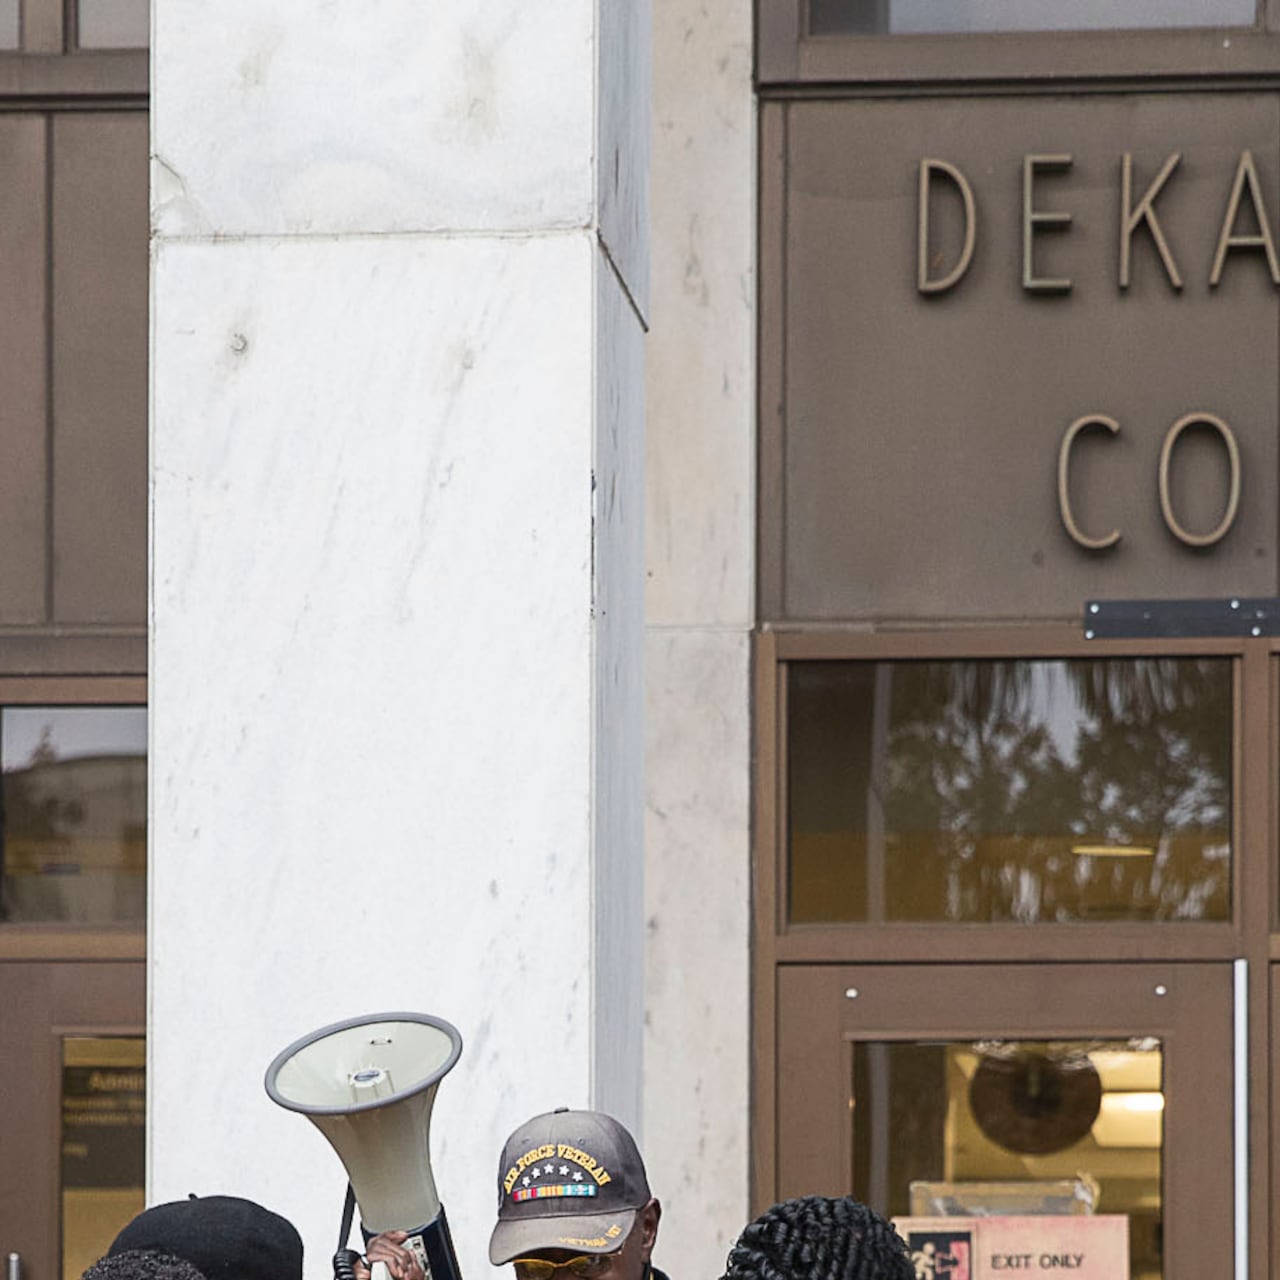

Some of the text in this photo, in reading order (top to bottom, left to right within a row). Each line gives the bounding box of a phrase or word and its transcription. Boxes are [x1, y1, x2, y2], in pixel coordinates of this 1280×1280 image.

[503, 1144, 612, 1194] AIR FORCE VETERAN
[991, 1253, 1086, 1270] EXIT ONLY
